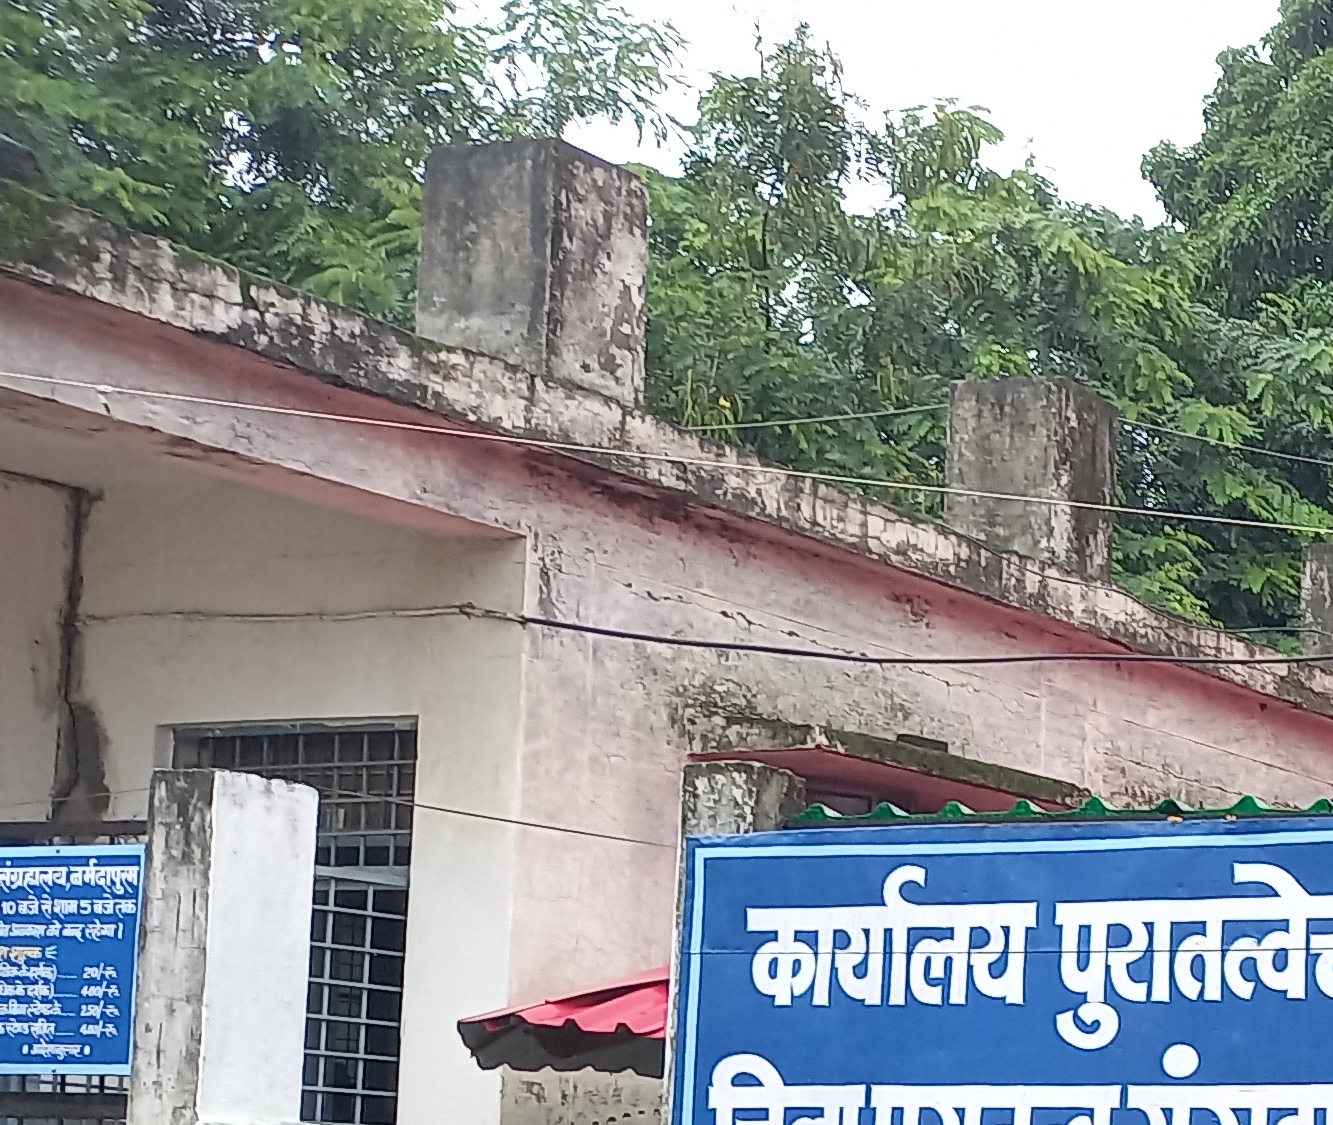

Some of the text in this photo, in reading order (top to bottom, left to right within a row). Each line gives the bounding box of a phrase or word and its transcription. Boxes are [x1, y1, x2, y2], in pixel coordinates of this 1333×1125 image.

[1, 901, 16, 915] 10
[16, 894, 40, 915] बजे
[79, 900, 92, 914] 5
[92, 893, 115, 914] बजे
[114, 899, 137, 918] तक
[746, 865, 1039, 1007] कार्यालय
